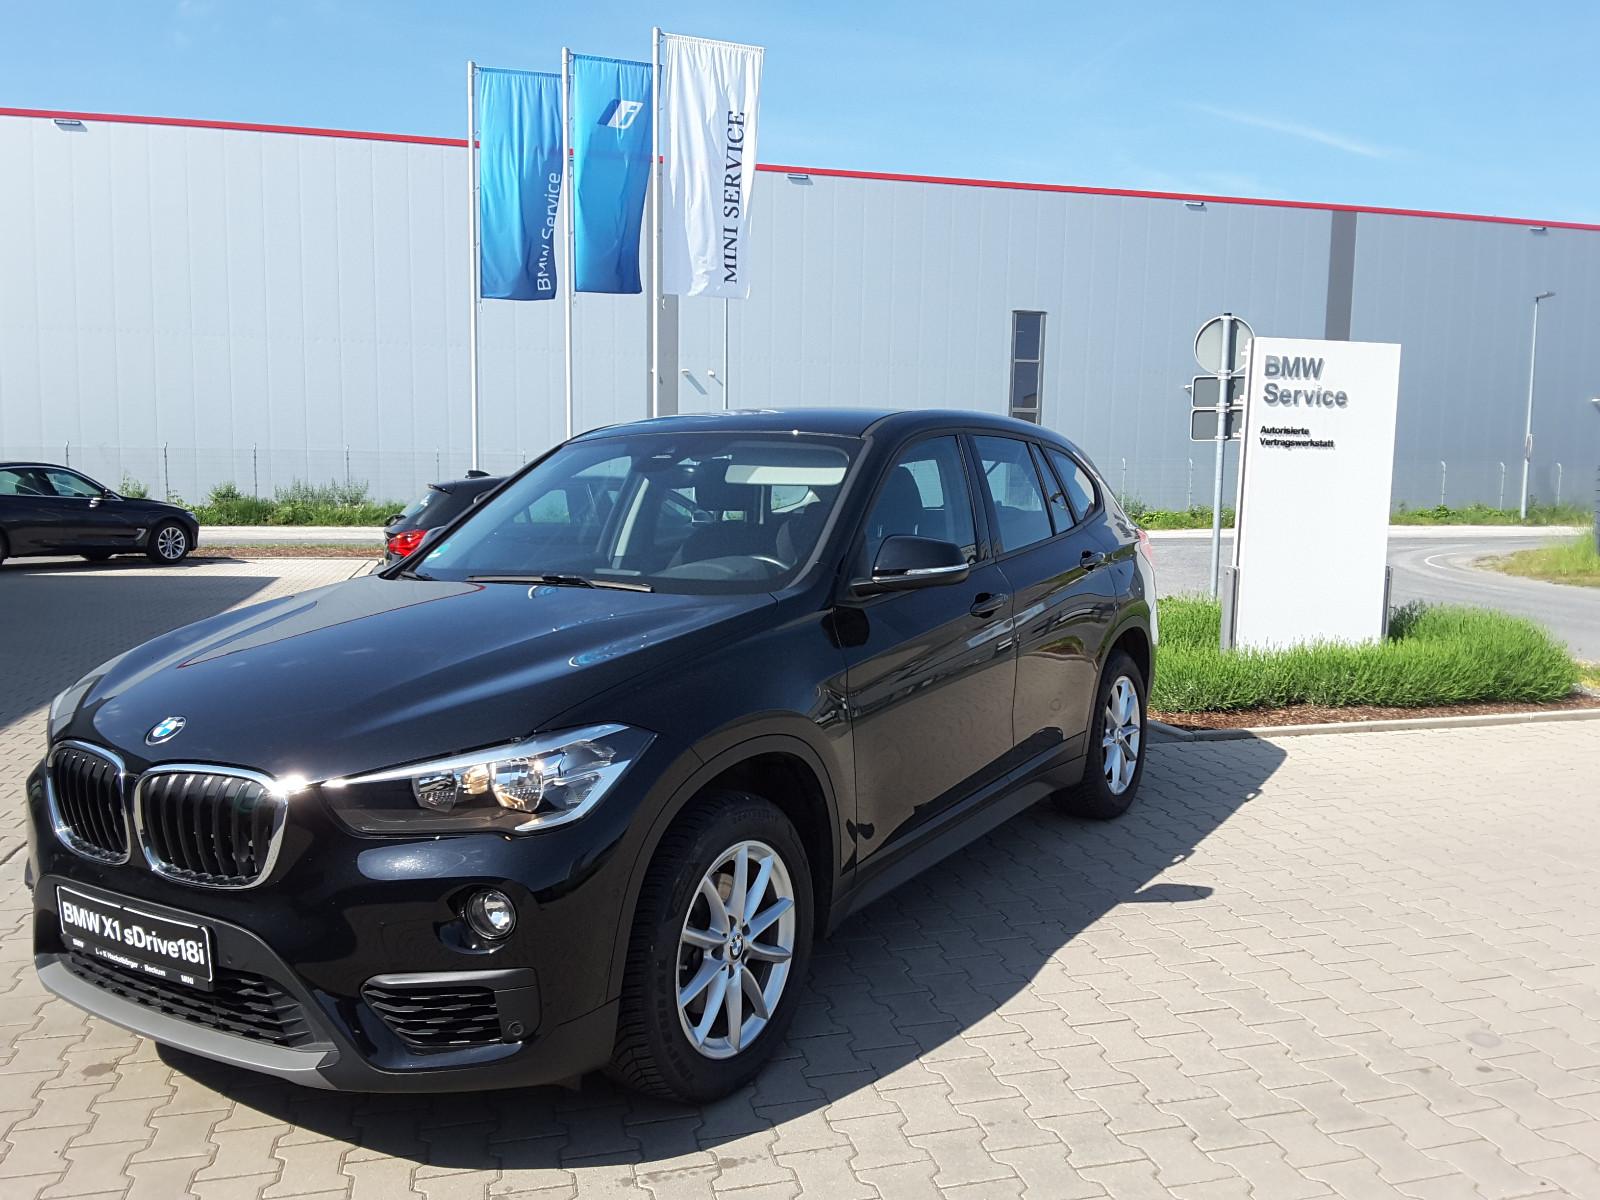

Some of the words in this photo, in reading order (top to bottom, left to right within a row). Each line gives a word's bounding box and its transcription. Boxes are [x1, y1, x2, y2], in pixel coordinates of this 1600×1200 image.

[723, 110, 745, 219] SERVICE
[542, 172, 561, 240] Service
[723, 225, 739, 284] MINI
[1263, 355, 1325, 380] BMW
[1262, 383, 1348, 407] Service
[1260, 426, 1309, 436] Autorisierte
[1260, 437, 1335, 448] Vertragswerkstatt
[62, 901, 100, 934] BMW
[101, 915, 121, 942] X1
[123, 925, 205, 965] sDrive18i
